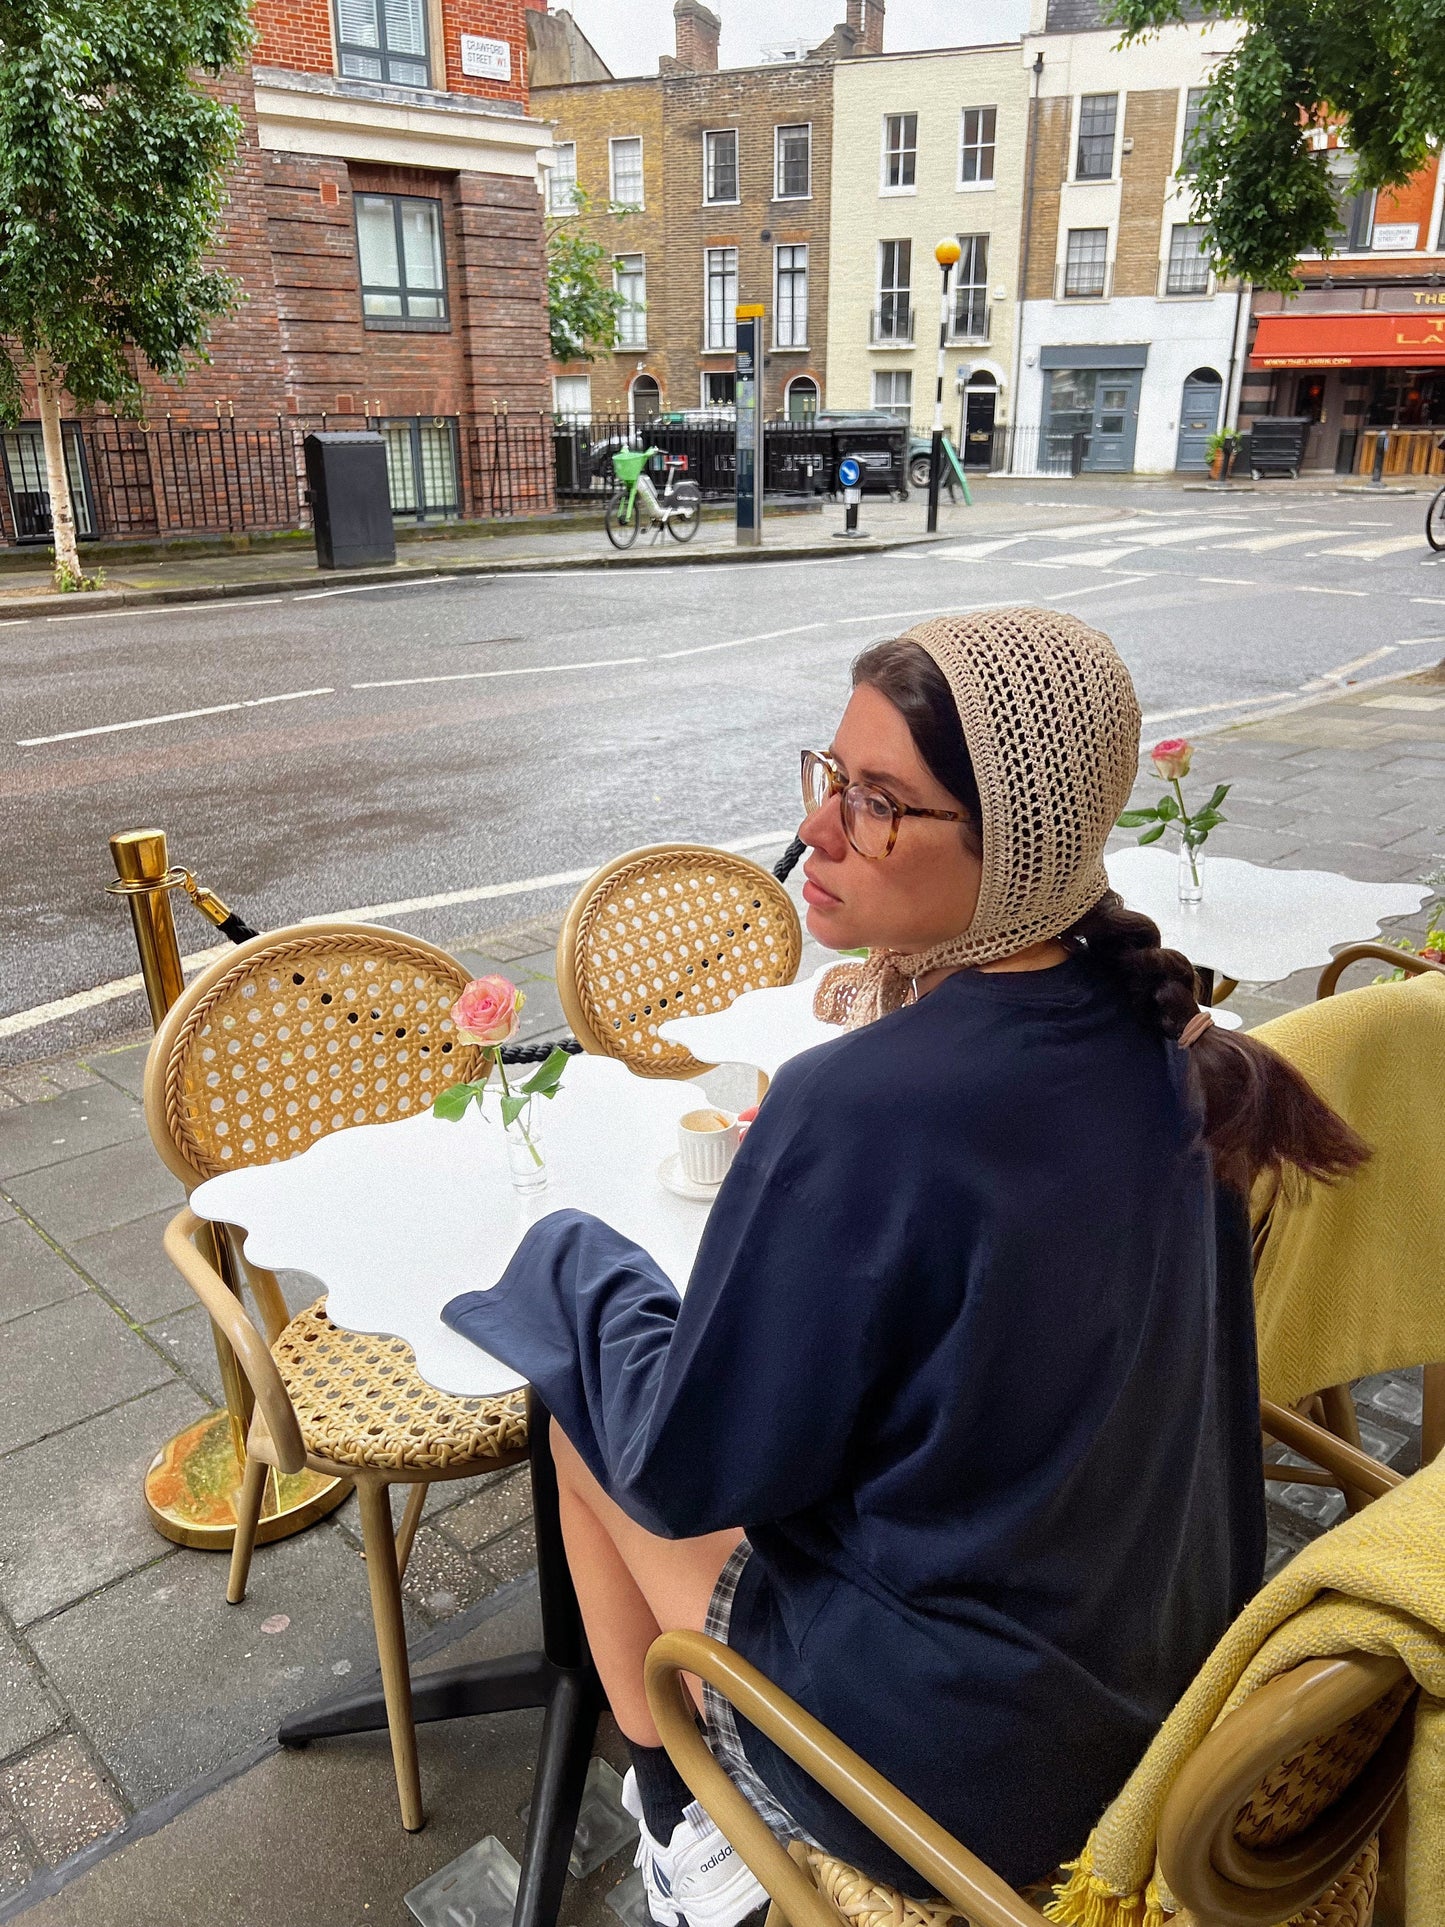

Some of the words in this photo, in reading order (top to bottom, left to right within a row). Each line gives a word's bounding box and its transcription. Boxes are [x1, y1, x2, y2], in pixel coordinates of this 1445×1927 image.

[466, 40, 504, 55] CRAWFORD
[467, 52, 492, 65] STREET
[1413, 292, 1445, 305] THE
